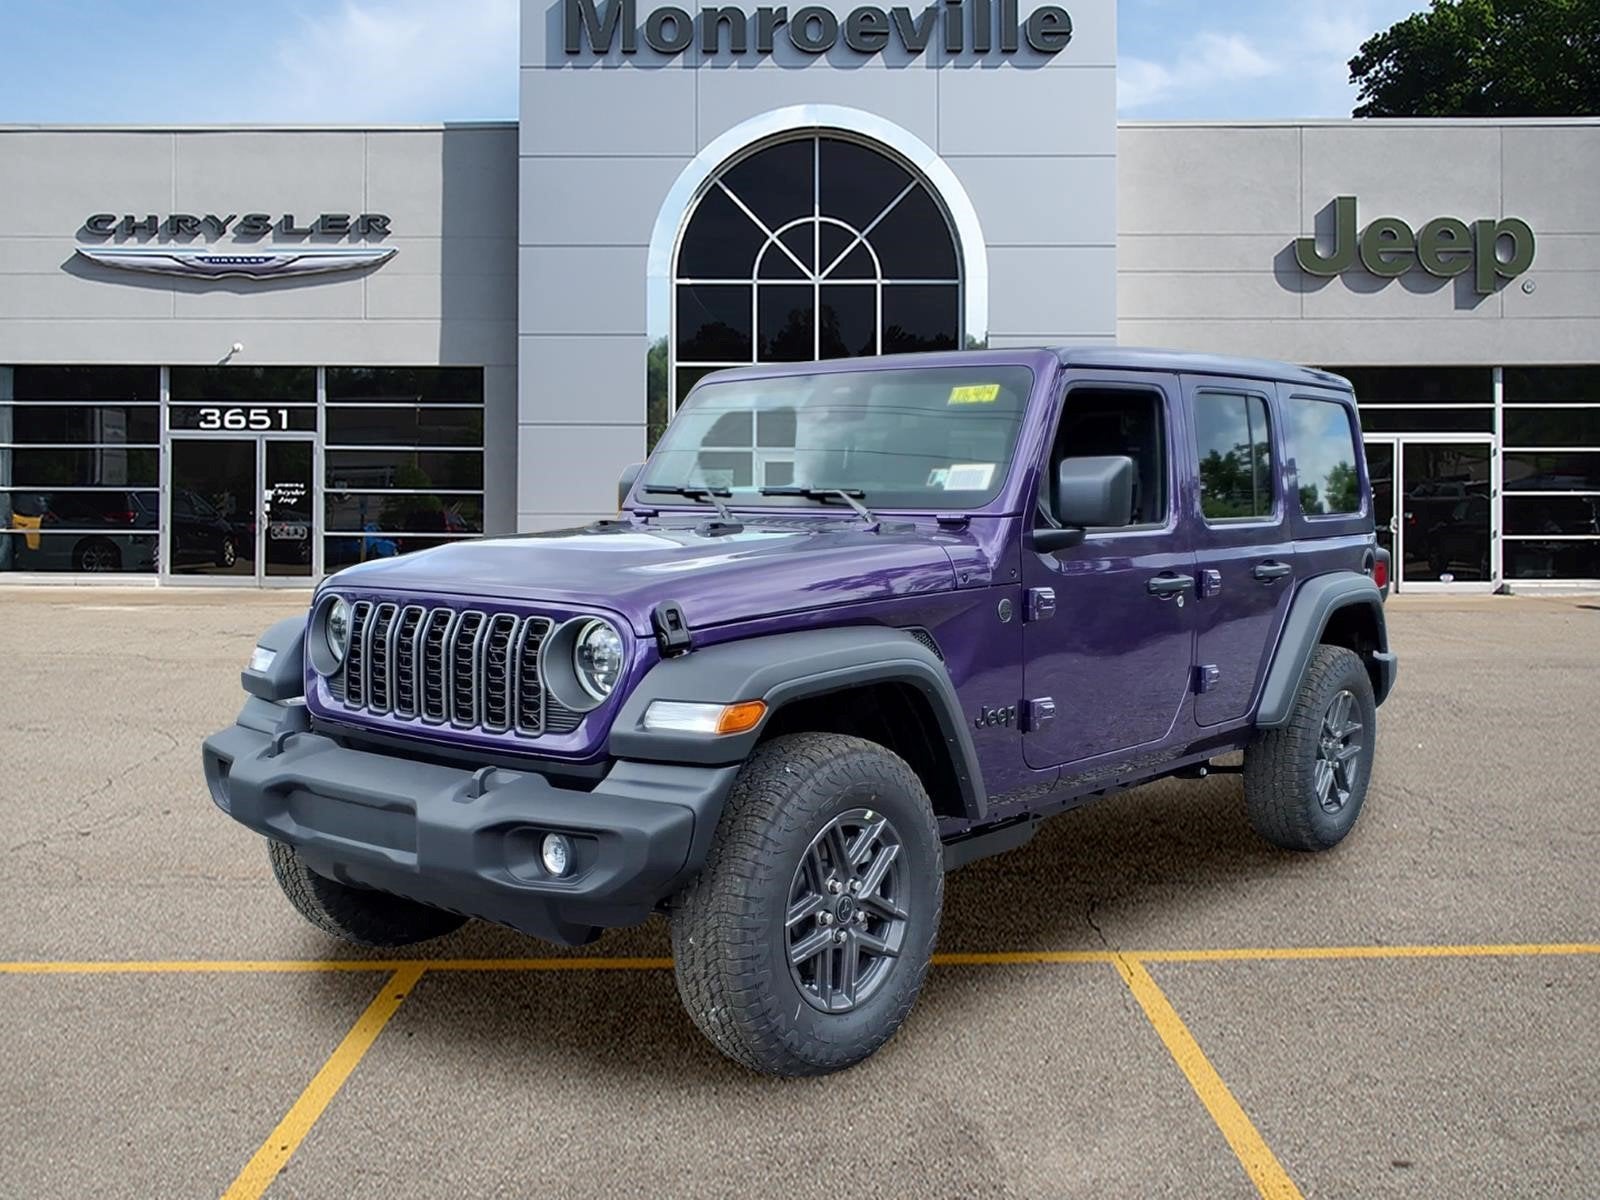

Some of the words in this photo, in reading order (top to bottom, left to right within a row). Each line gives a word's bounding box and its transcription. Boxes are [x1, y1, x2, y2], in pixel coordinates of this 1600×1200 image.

[563, 0, 1073, 54] Monroeville
[85, 214, 392, 236] CHRYSLER
[1295, 196, 1535, 294] Jeep
[199, 408, 288, 430] 3651
[975, 704, 1015, 729] Jeep
